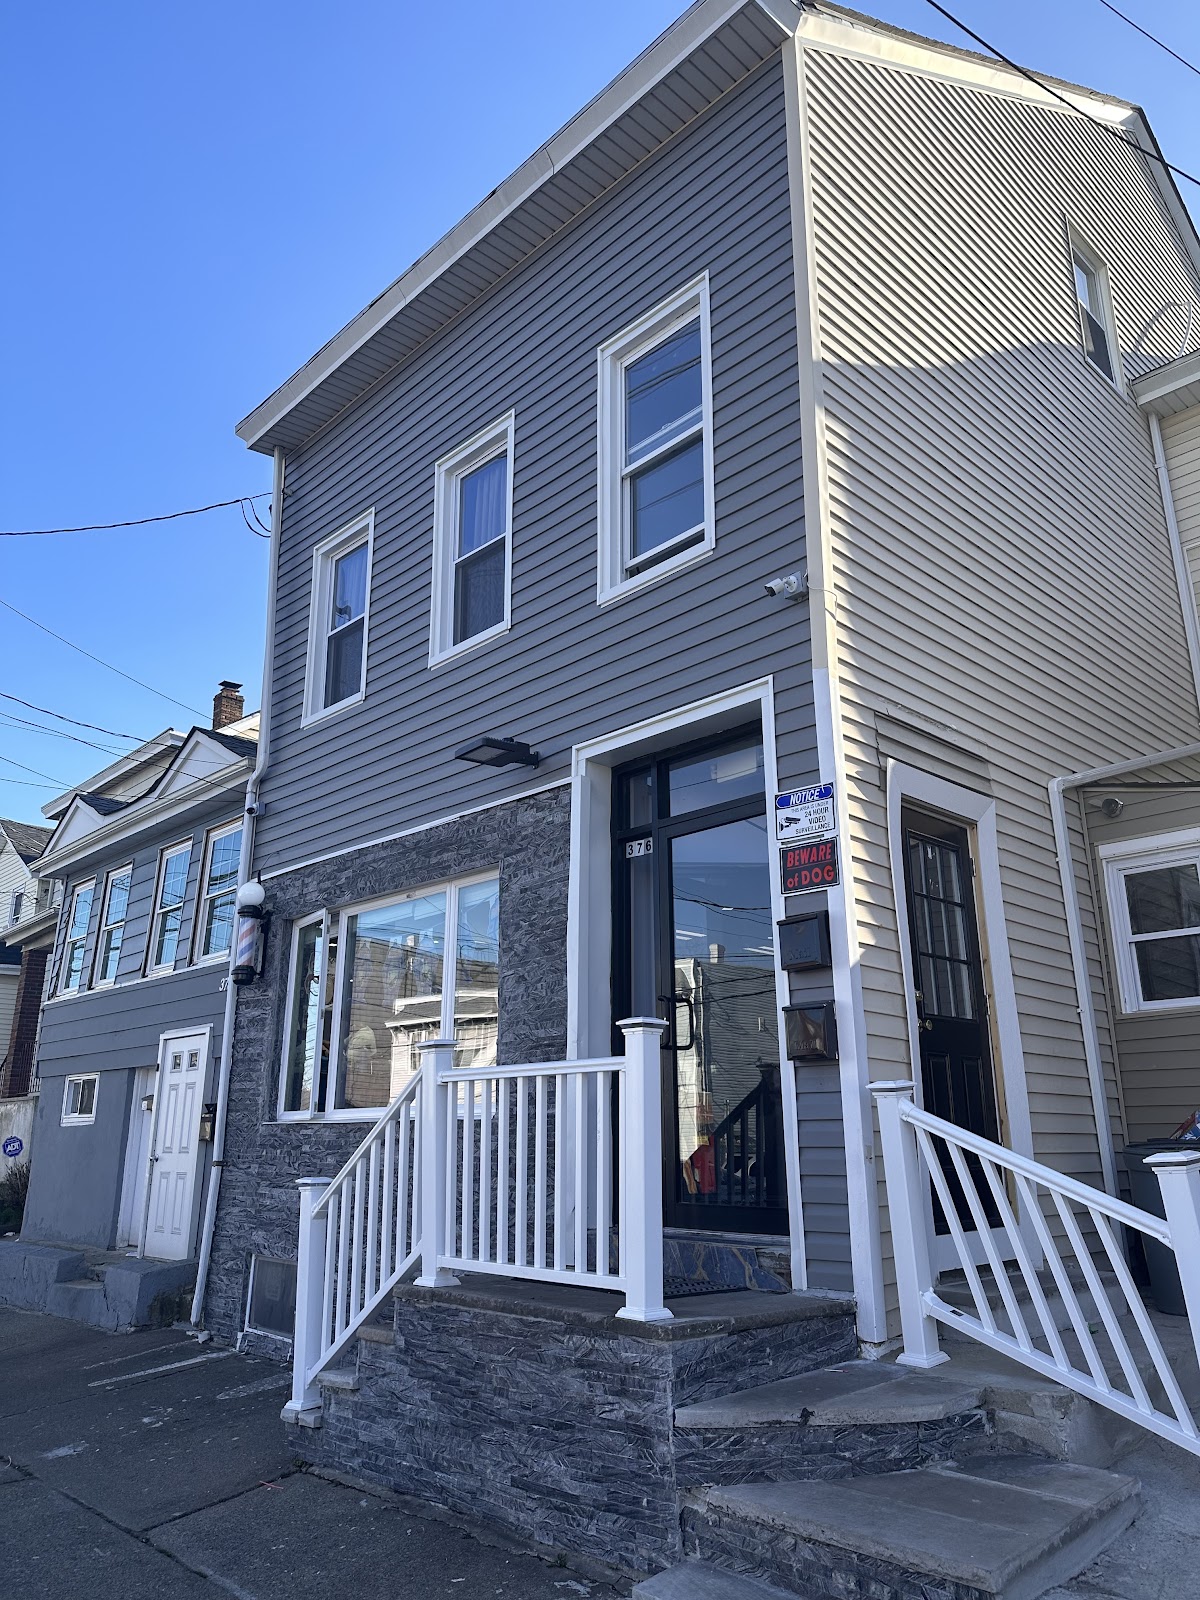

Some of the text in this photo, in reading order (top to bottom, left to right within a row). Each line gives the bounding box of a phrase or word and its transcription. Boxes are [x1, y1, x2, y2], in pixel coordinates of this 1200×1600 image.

[789, 788, 820, 806] NOTICE
[805, 806, 829, 818] 24 HOUR
[808, 815, 827, 825] VIDEO
[795, 822, 831, 835] SURVEILLANCE
[628, 840, 652, 856] 376
[787, 843, 832, 867] BEWARE
[787, 865, 835, 889] of DOG
[7, 1142, 20, 1152] ADT
